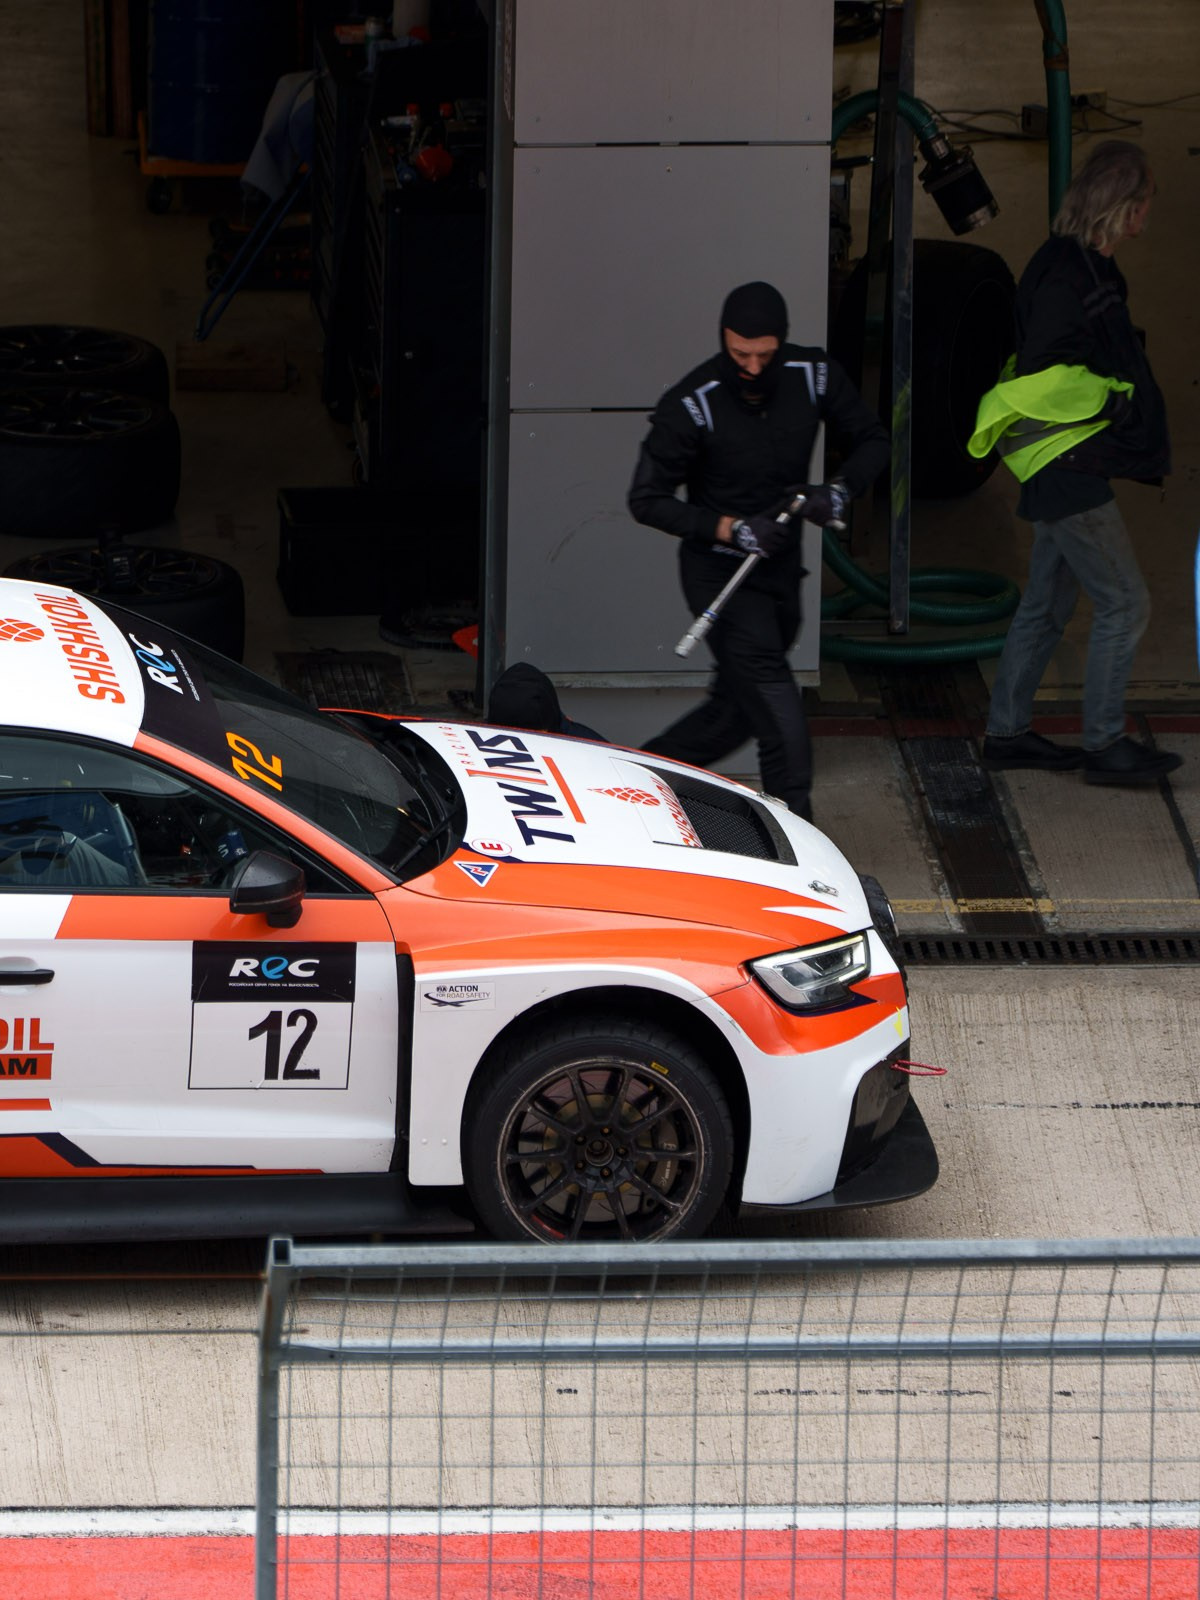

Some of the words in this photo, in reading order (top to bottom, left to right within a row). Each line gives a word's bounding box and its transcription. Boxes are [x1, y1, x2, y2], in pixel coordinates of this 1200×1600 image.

[34, 593, 126, 704] SHISHKOIL
[225, 731, 283, 792] 12
[449, 985, 479, 993] ACTION
[248, 1008, 321, 1081] 12
